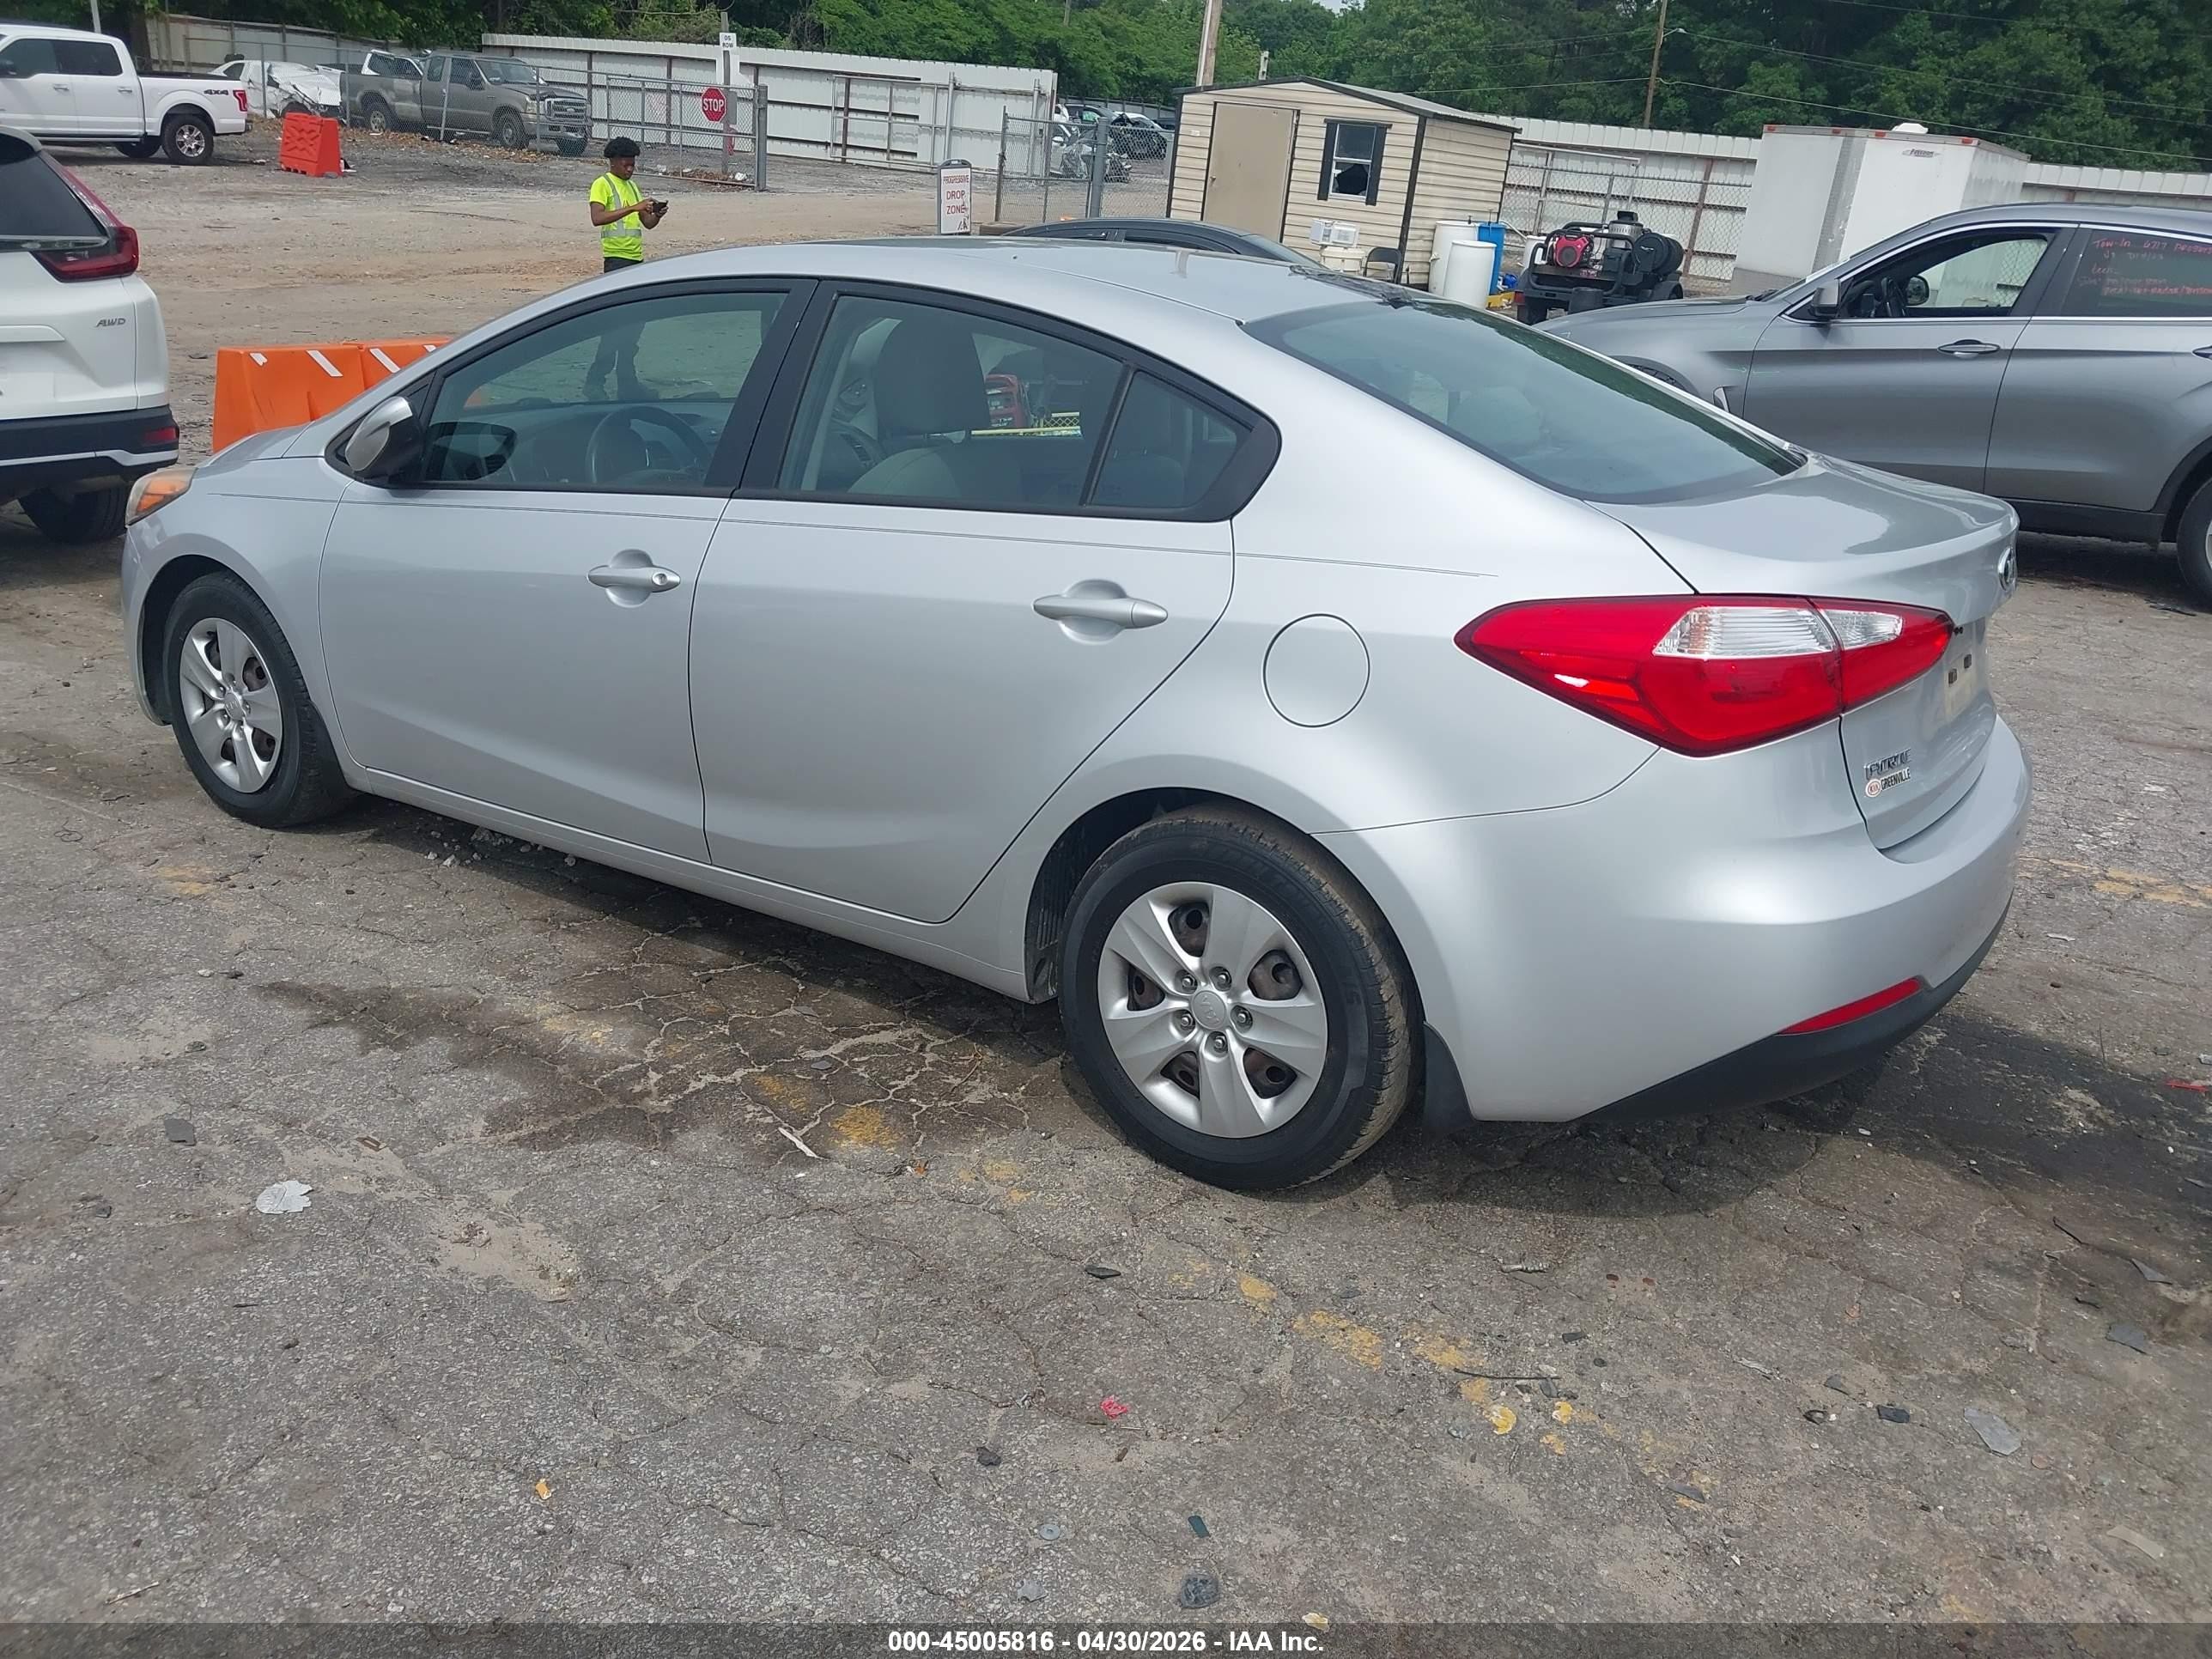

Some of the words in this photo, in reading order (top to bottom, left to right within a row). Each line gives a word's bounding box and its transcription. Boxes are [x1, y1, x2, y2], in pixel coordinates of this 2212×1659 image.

[702, 98, 725, 112] STOP
[946, 190, 965, 200] DROP
[946, 205, 966, 215] ZONE
[95, 317, 126, 327] AWD
[1881, 768, 1911, 791] GREENVILLE
